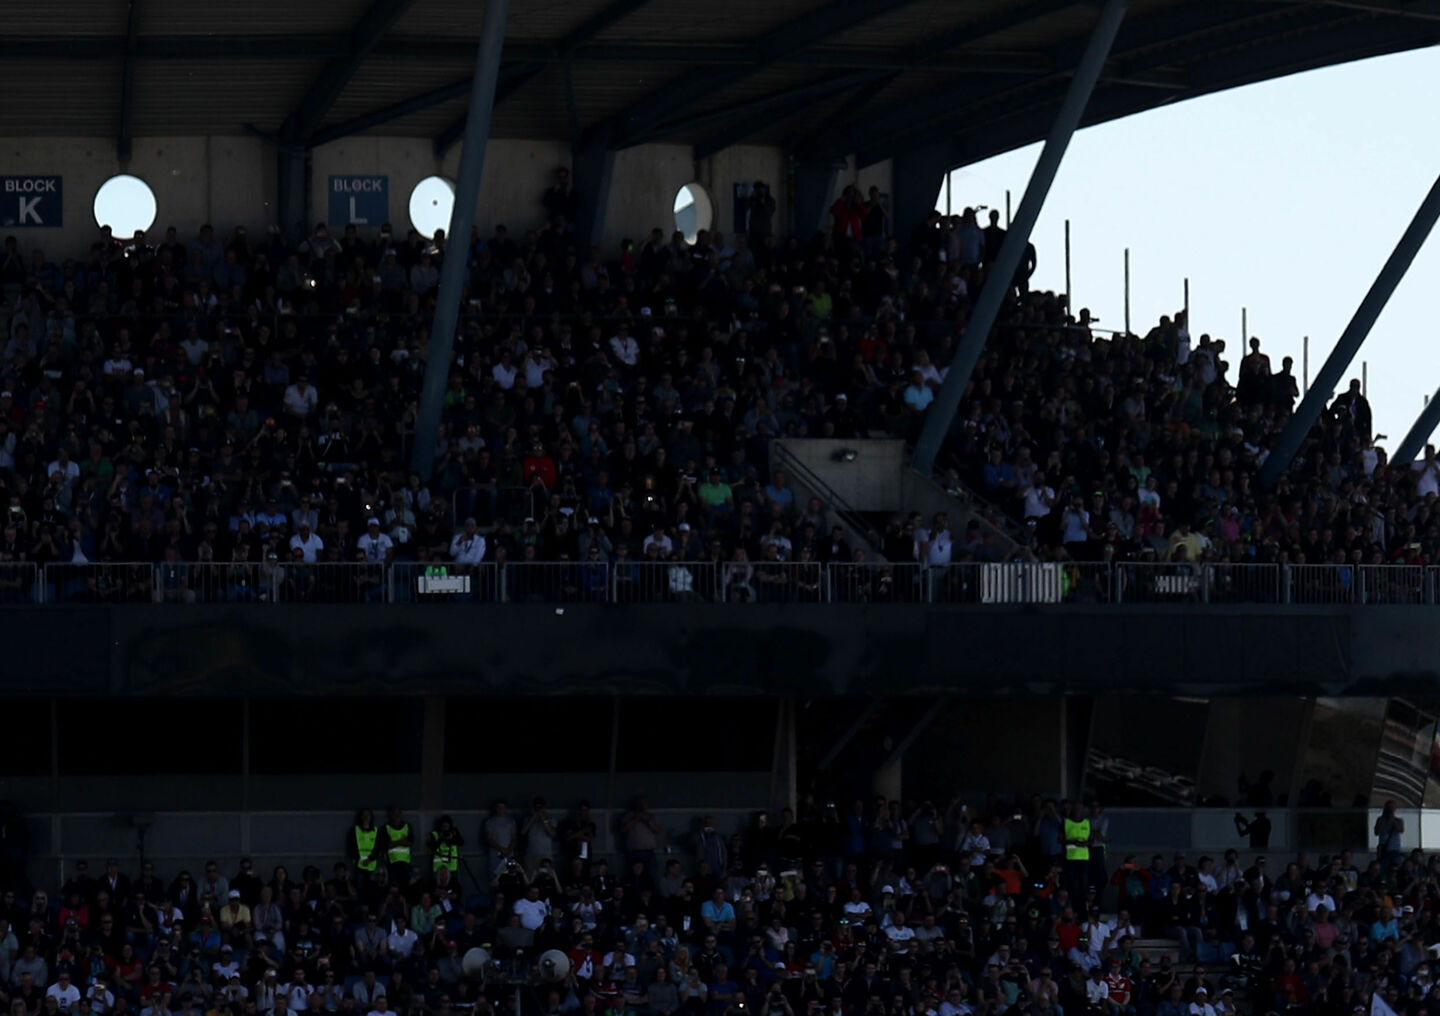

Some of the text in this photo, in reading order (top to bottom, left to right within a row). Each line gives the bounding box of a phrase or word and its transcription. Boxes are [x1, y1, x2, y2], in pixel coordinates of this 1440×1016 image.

[5, 179, 56, 193] BLOCK
[334, 179, 382, 193] BLOCK
[18, 196, 45, 224] K
[349, 197, 368, 224] L
